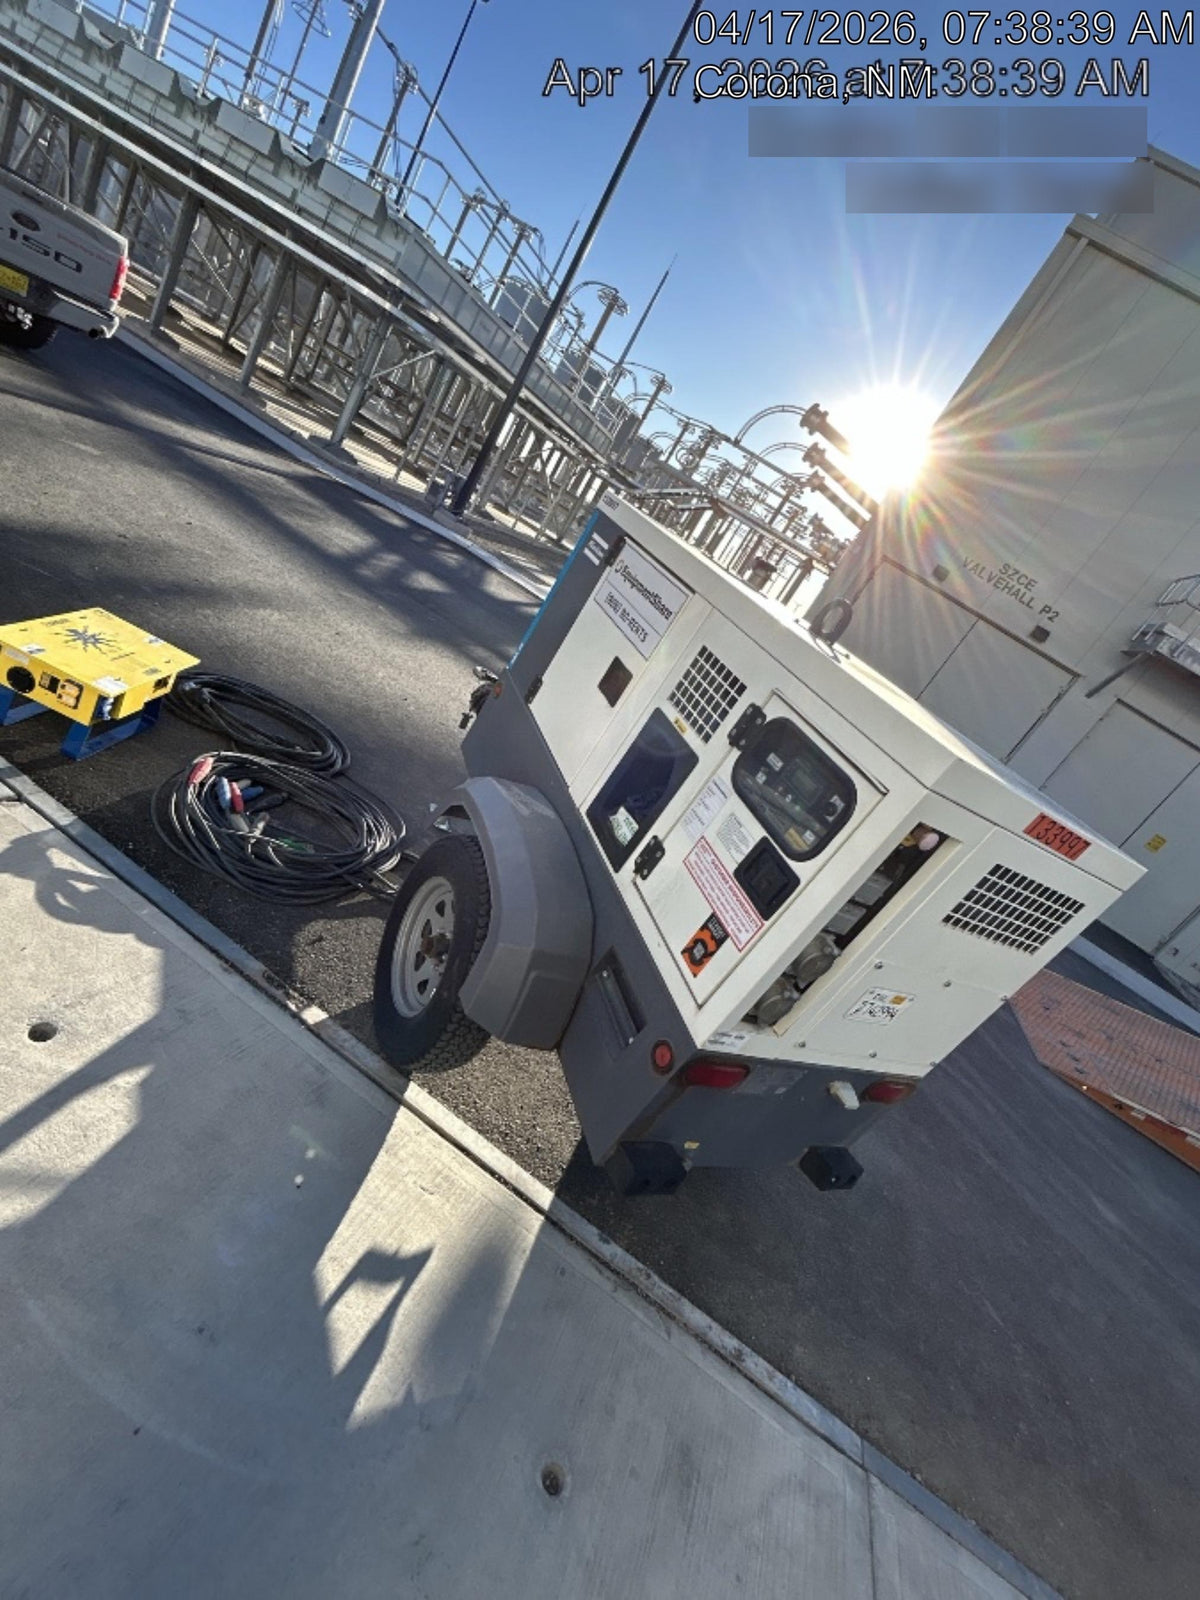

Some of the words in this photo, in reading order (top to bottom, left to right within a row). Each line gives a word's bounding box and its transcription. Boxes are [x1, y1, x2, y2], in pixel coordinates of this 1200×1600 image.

[0, 226, 83, 273] 150
[962, 556, 1035, 610] VALVEHALL
[1038, 604, 1061, 623] P2
[999, 562, 1039, 592] SZCE
